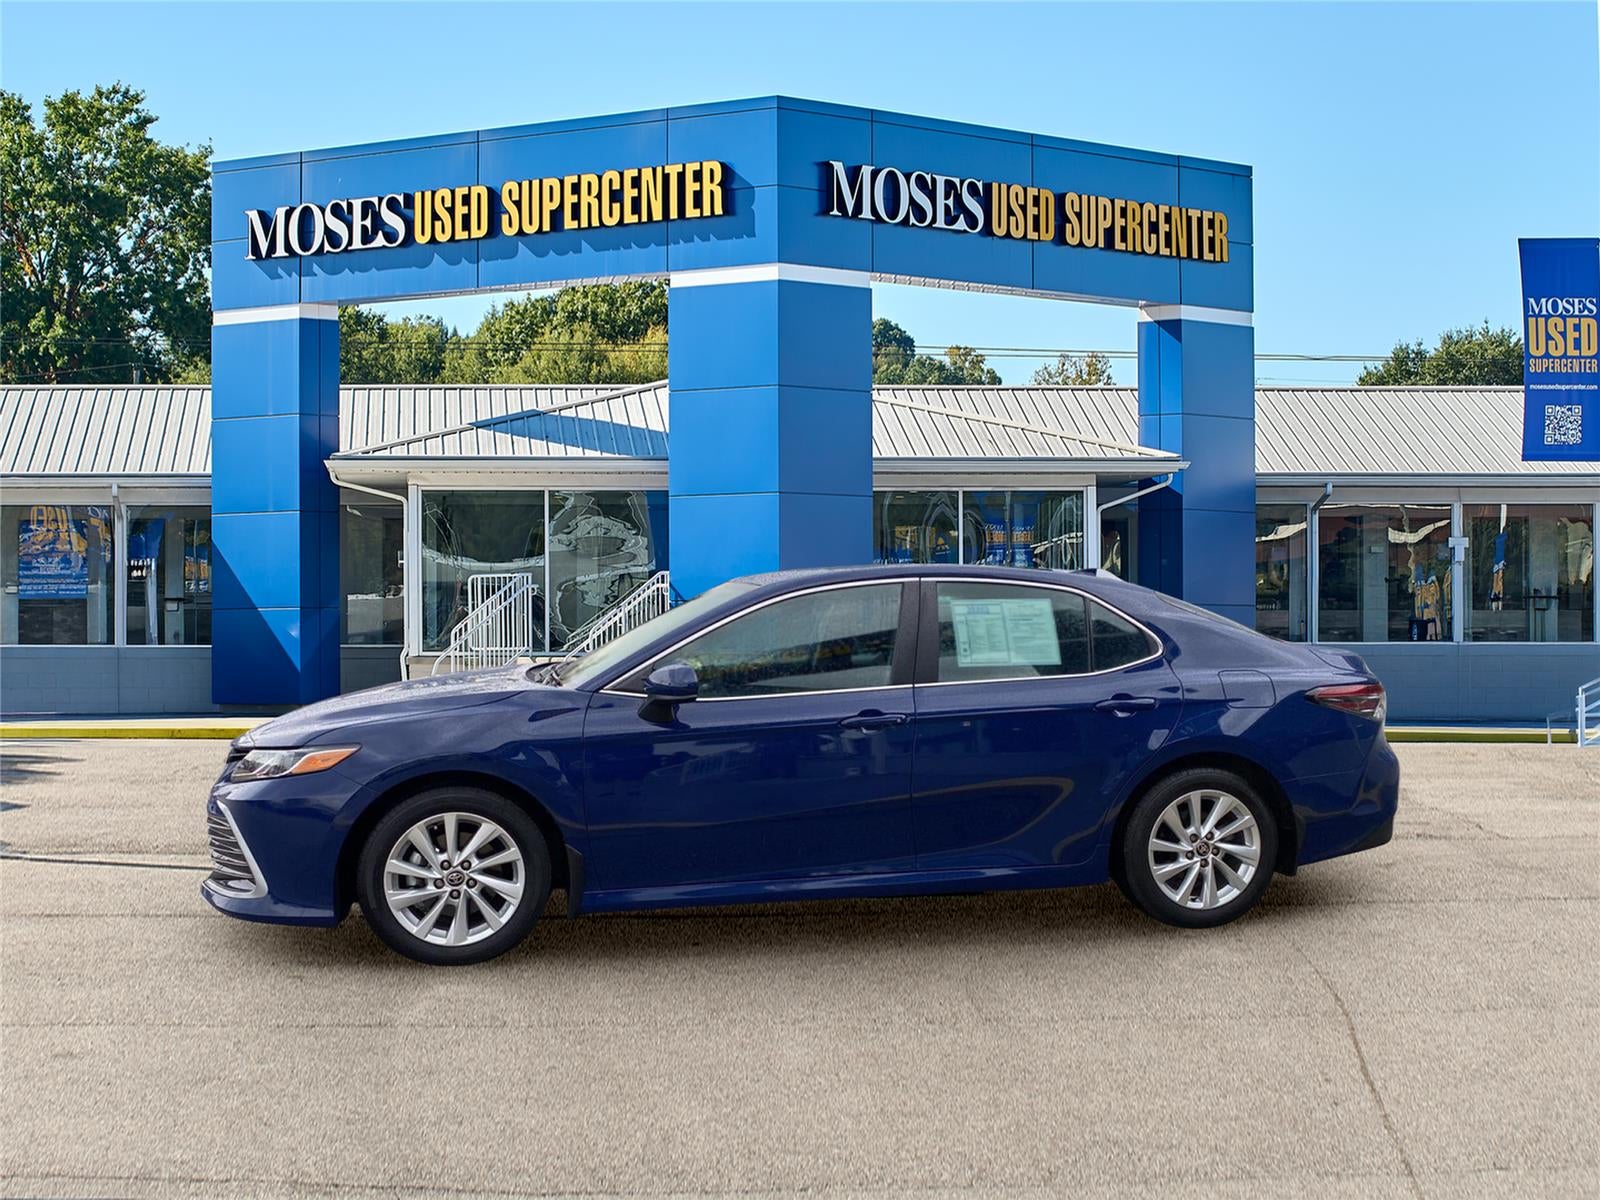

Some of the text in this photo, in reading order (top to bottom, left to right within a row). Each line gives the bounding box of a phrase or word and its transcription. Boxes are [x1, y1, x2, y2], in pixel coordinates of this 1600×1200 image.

[245, 160, 724, 260] MOSES USED SUPERCENTER
[829, 160, 1229, 263] MOSES USED SUPERCENTER
[1527, 297, 1597, 316] MOSES
[1528, 317, 1598, 357] USED
[1529, 358, 1598, 373] SUPERCENTER
